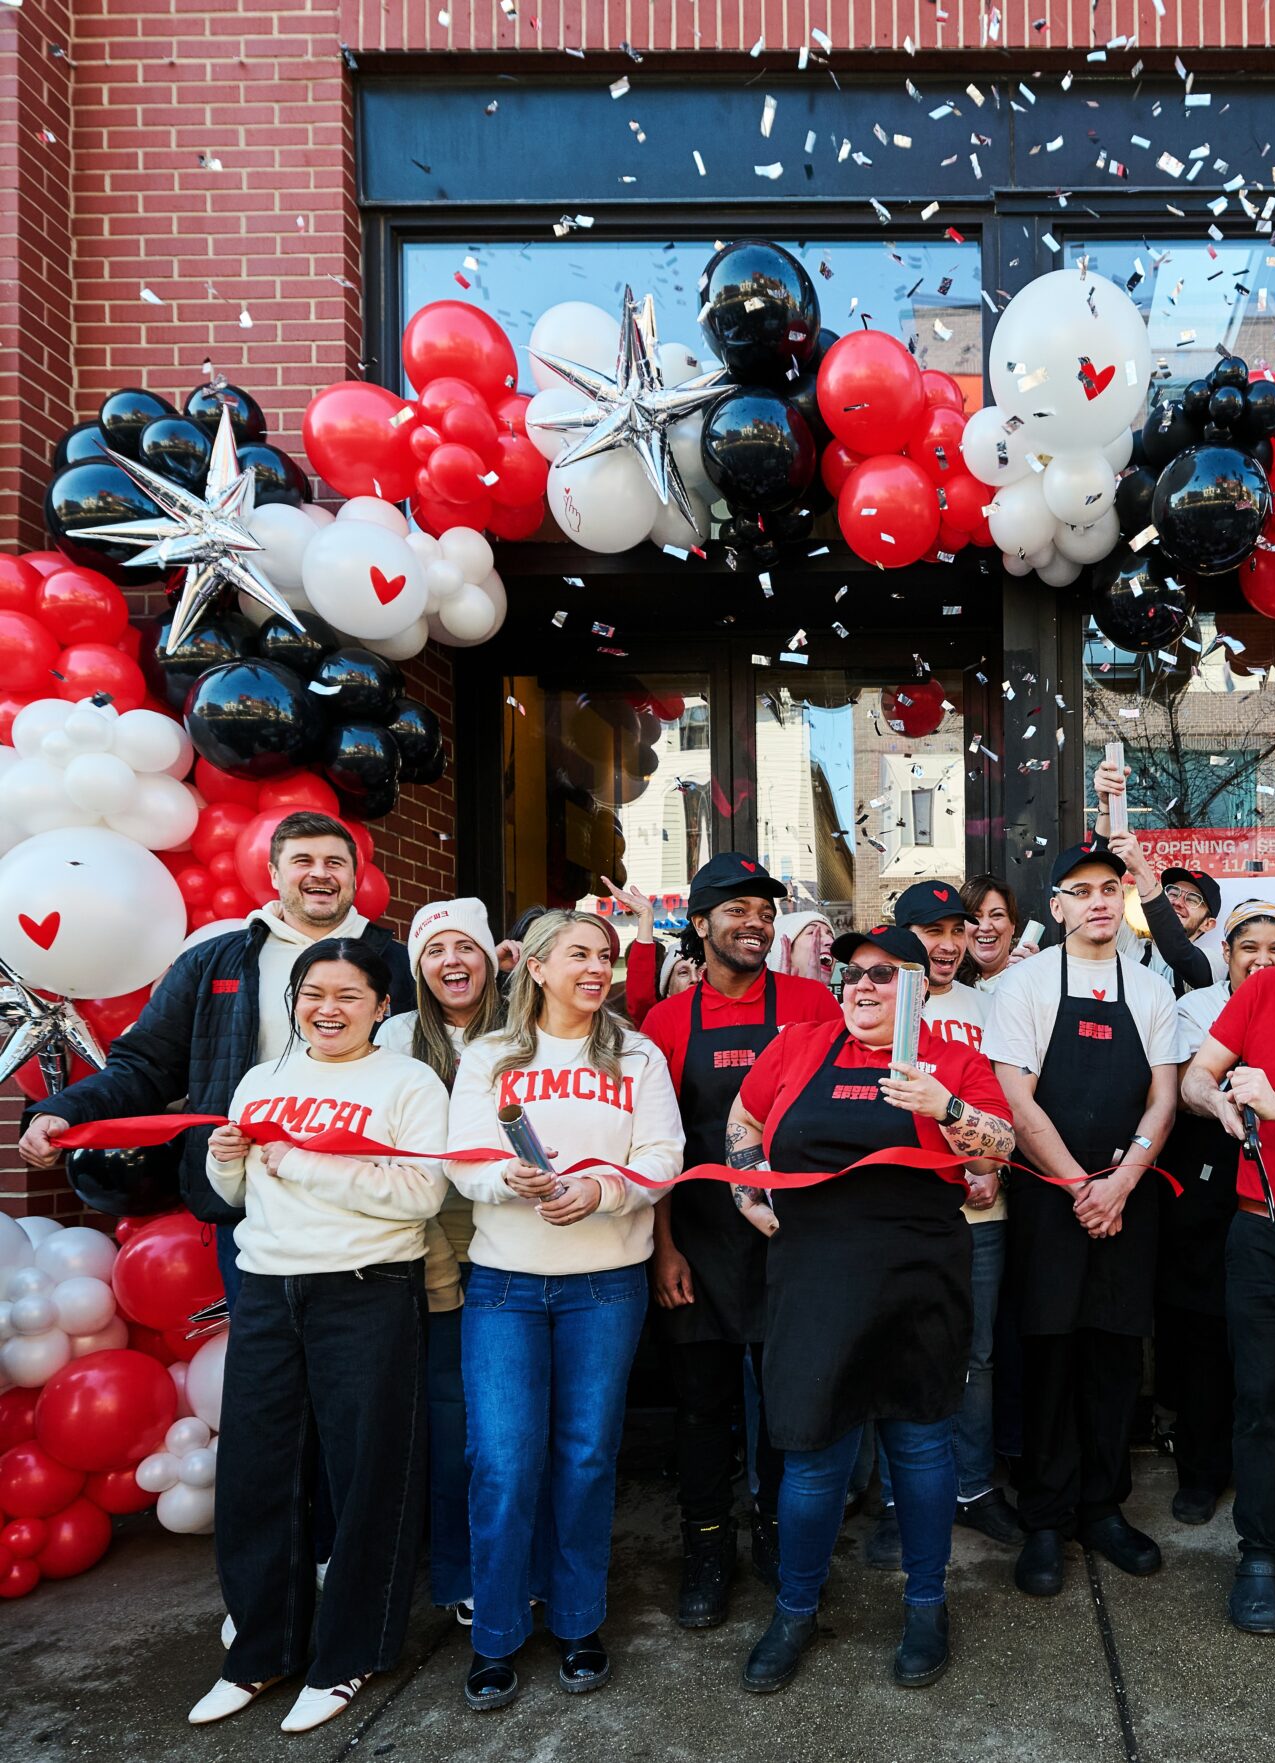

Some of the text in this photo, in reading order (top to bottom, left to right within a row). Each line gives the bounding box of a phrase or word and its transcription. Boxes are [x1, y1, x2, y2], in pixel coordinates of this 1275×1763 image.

[1156, 840, 1236, 855] OPENING
[498, 1067, 634, 1114] KIMCHI
[240, 1097, 373, 1136] KIMCHI
